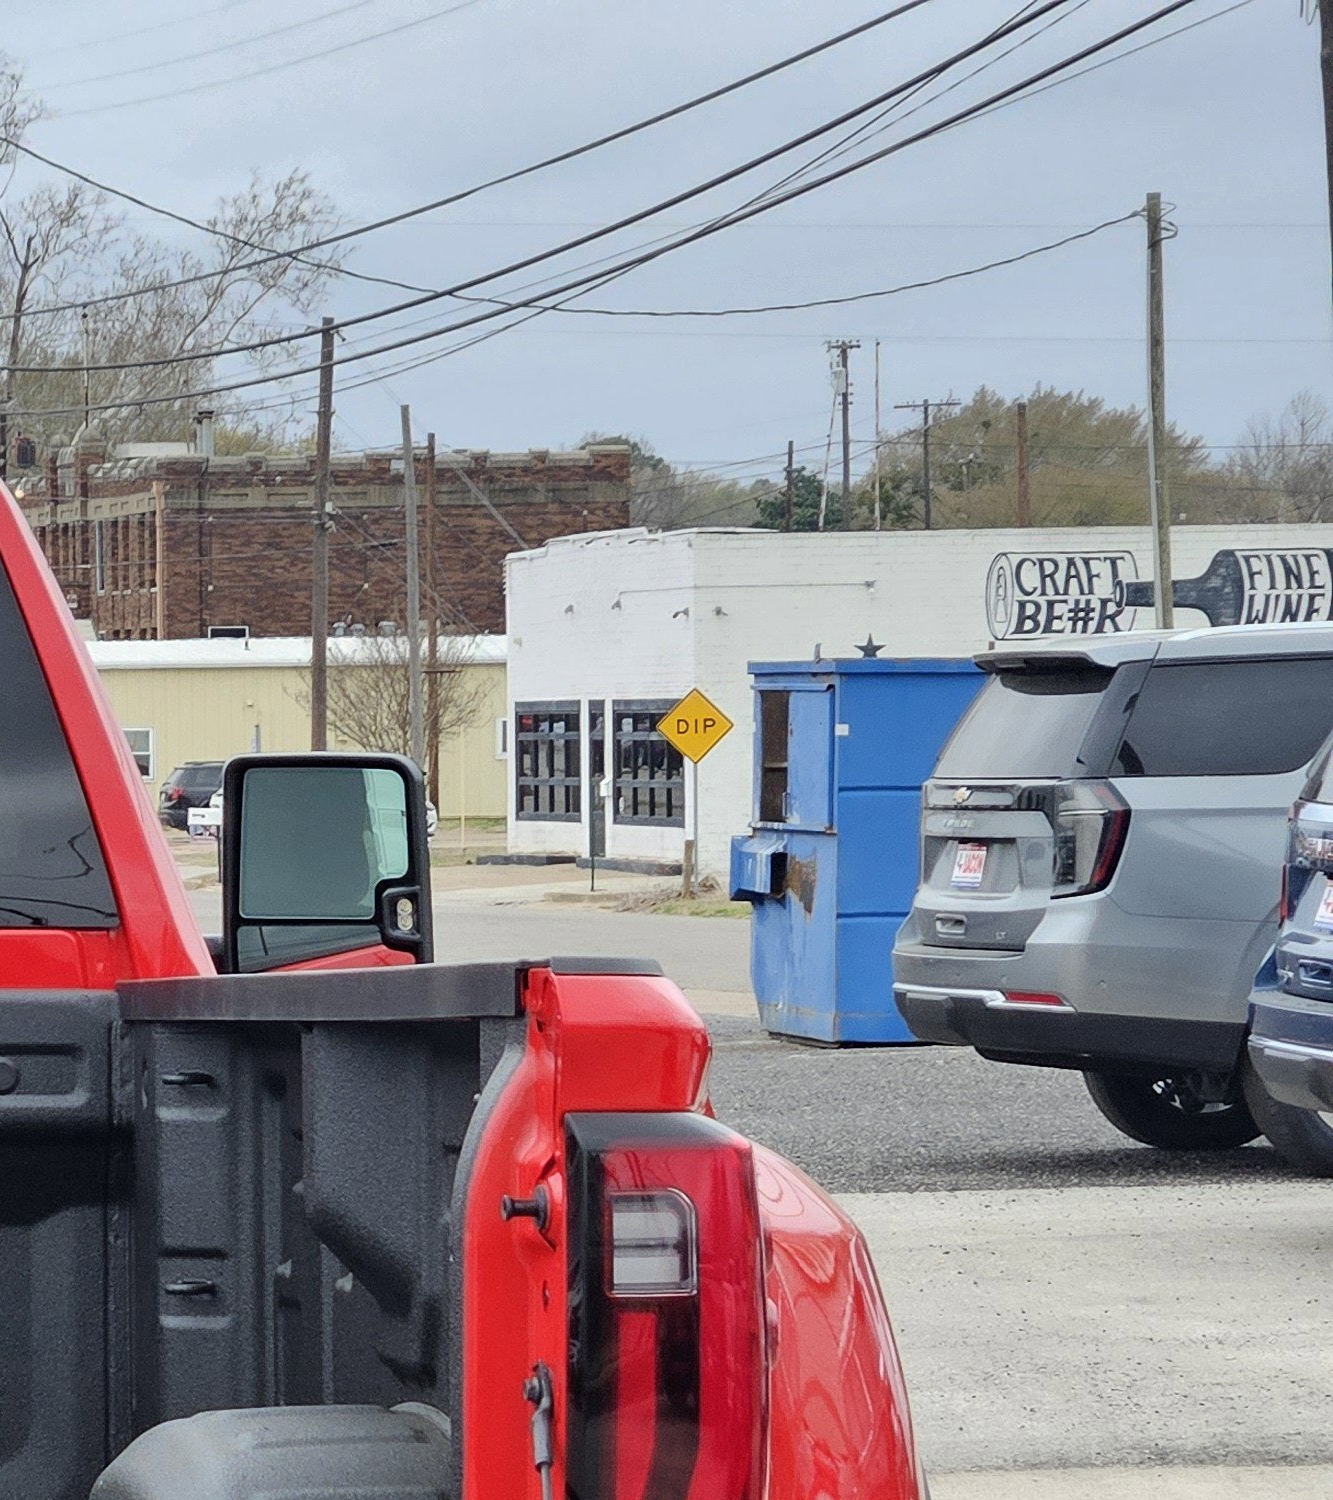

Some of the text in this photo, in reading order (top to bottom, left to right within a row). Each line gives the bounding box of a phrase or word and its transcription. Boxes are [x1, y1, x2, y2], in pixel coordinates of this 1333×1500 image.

[1014, 556, 1126, 597] CRAFT
[1240, 553, 1326, 591] FINE
[1009, 597, 1125, 635] BE#R
[676, 717, 717, 735] DIP
